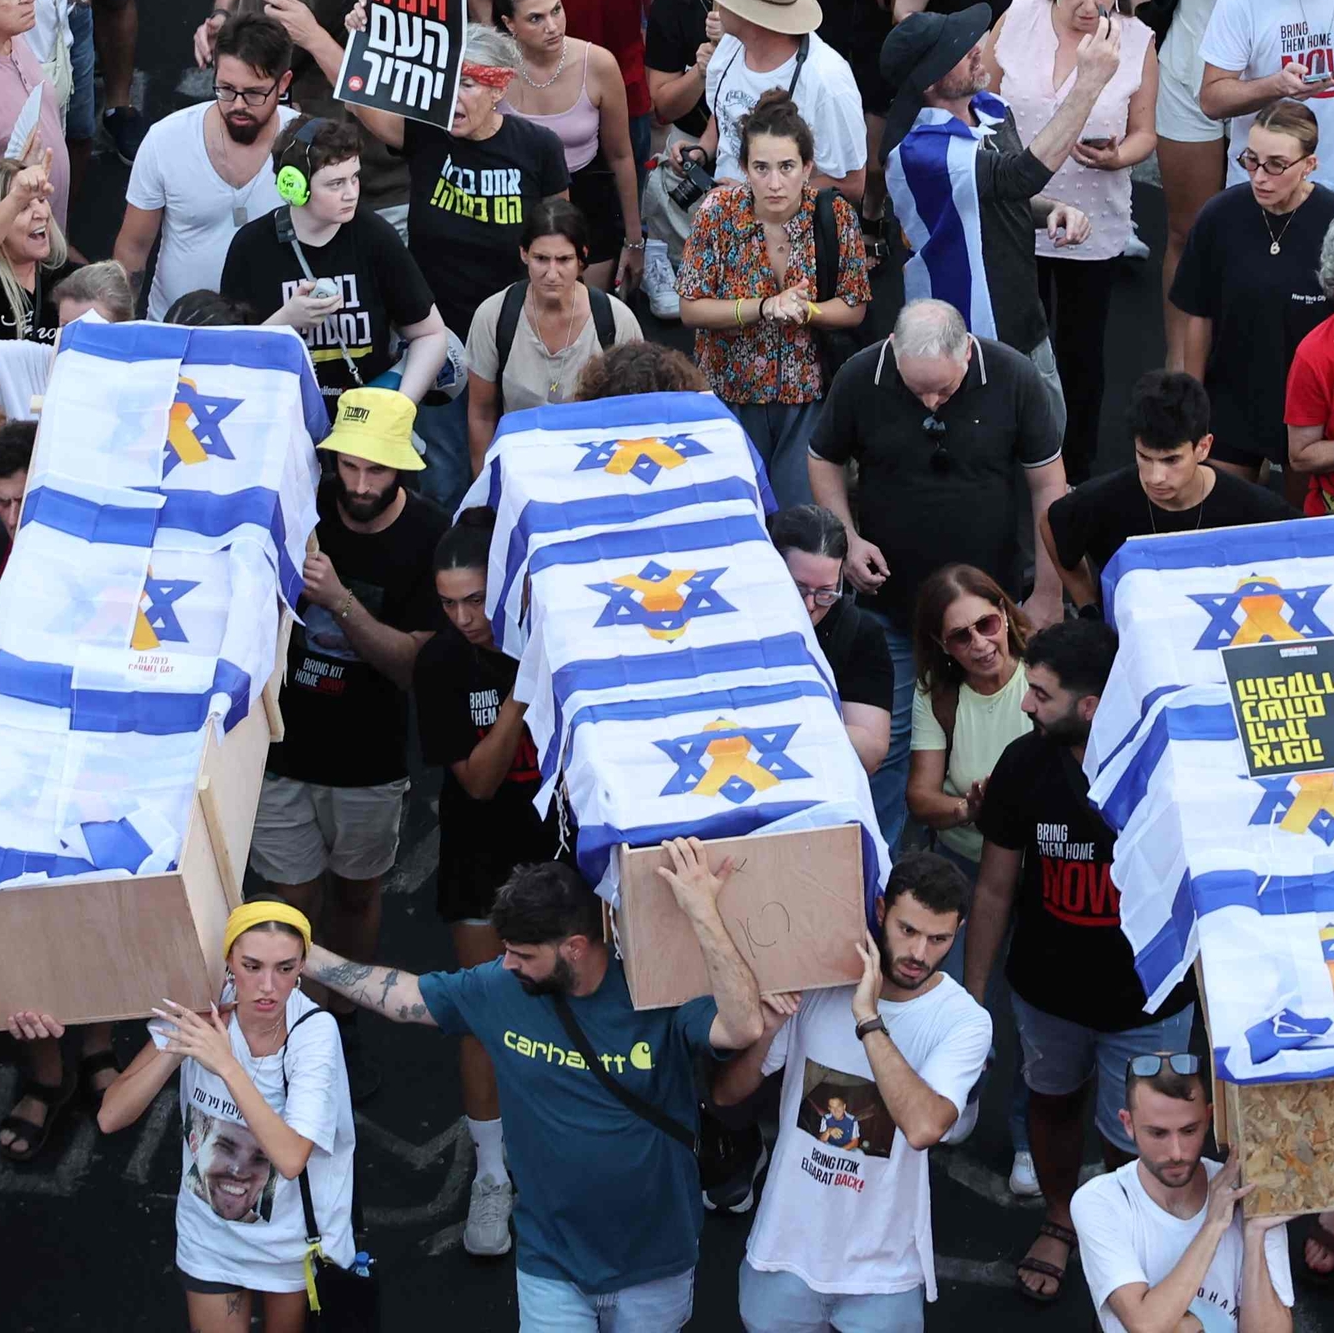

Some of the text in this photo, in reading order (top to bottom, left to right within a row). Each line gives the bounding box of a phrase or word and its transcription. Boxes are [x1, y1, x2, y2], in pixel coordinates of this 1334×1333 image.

[368, 2, 450, 70] העם
[1280, 21, 1309, 41] BRING
[1281, 32, 1333, 54] THEM HOME
[362, 50, 446, 111] יחזיר
[480, 168, 523, 196] אתם
[495, 195, 524, 224] הם
[294, 668, 320, 688] HOME
[302, 657, 345, 680] BRING KIT
[468, 689, 499, 710] BRING
[1241, 695, 1327, 723] כשהם
[1037, 823, 1068, 843] BRING
[1038, 841, 1096, 861] THEM HOME
[503, 1030, 626, 1074] carhatt
[811, 1146, 861, 1175] BRING ITZIK
[833, 1172, 865, 1194] BACK!
